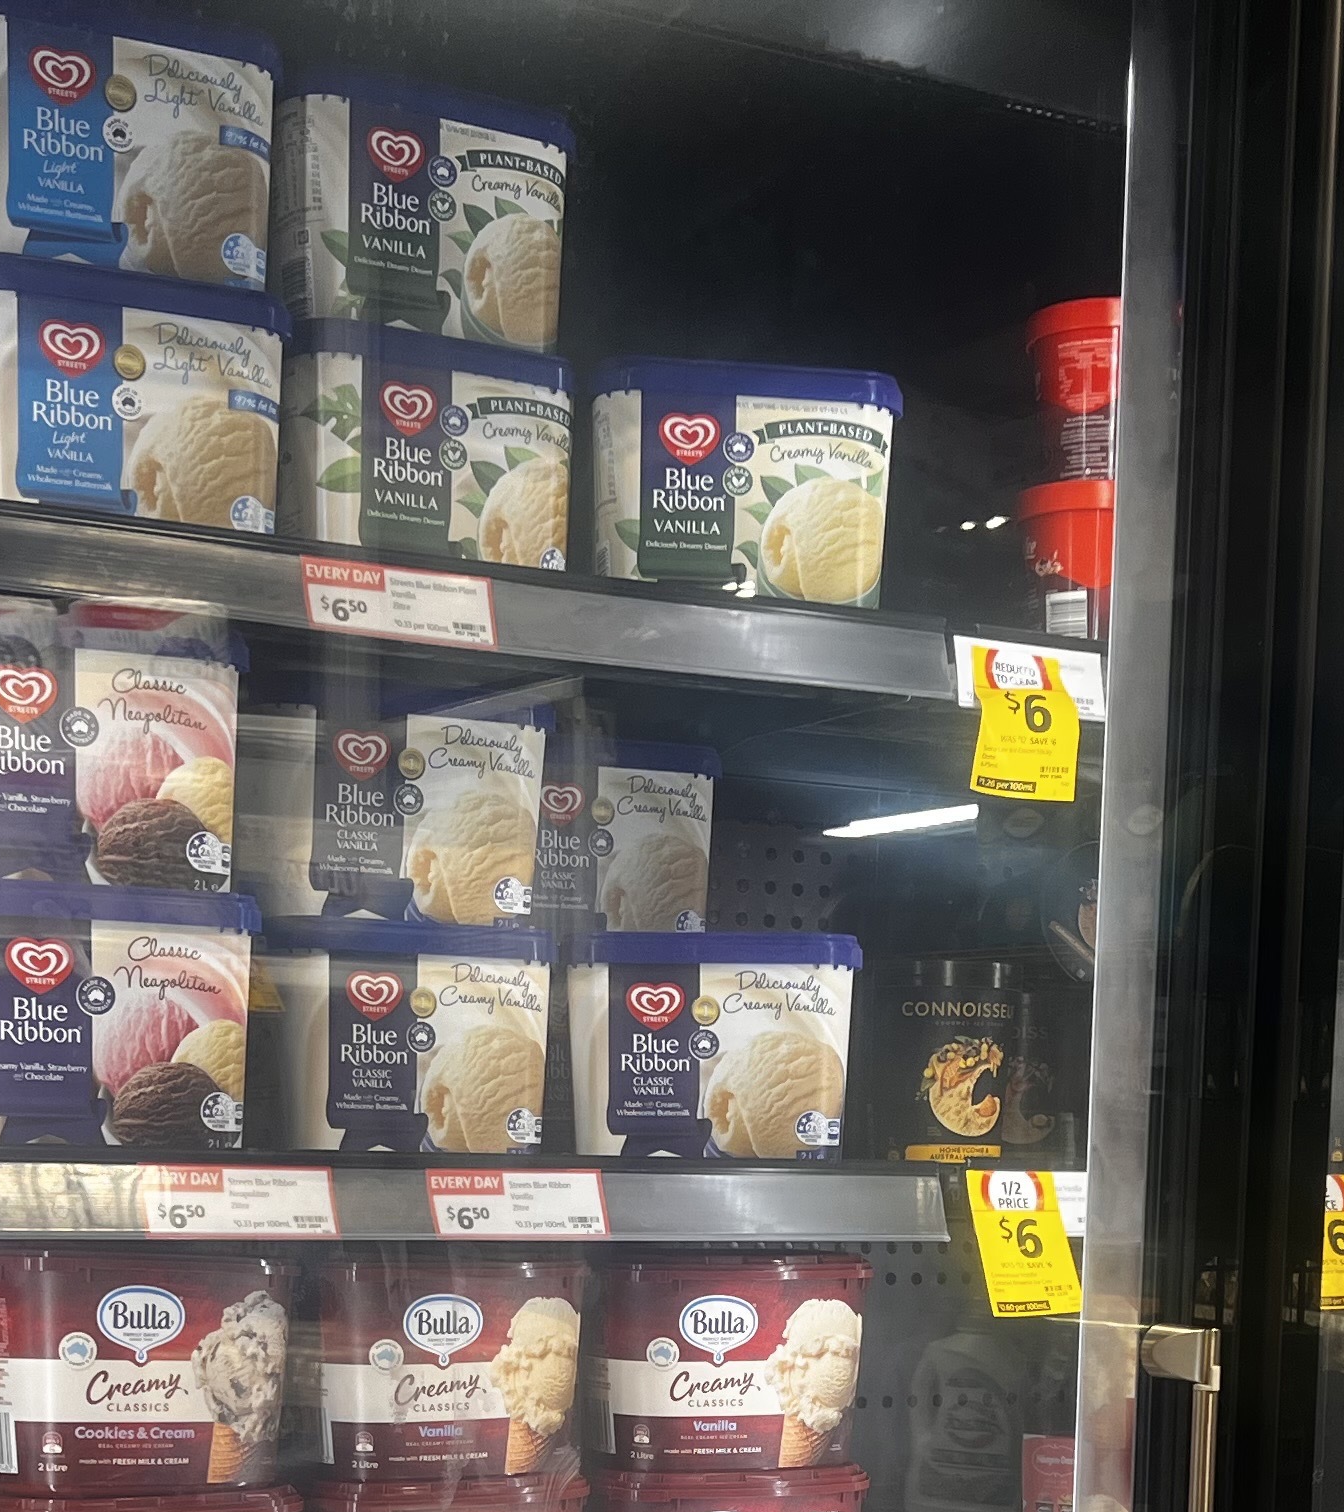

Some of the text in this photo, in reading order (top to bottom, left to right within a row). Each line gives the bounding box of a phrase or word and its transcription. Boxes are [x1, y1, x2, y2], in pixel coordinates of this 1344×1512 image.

[45, 380, 100, 407] Blue
[32, 402, 113, 431] Ribbon
[778, 421, 874, 443] PLANT-BASED
[47, 448, 94, 465] VANILLA
[770, 445, 873, 469] Creamy Vanilla
[664, 467, 714, 493] Blue
[652, 489, 726, 513] Ribbon
[653, 519, 721, 536] VANILLA
[305, 565, 382, 585] EVERY DAY
[128, 937, 202, 962] Classic
[116, 966, 222, 1000] Neapolitan
[735, 971, 821, 1001] Deliciously
[723, 992, 836, 1018] Creamy Vanilla
[633, 1077, 673, 1088] CLASSIC
[633, 1086, 674, 1096] VANILLA
[1001, 1182, 1022, 1195] 1/2
[999, 1198, 1028, 1210] PRICE
[110, 1300, 172, 1331] Bulla
[691, 1310, 748, 1337] Bulla
[86, 1370, 186, 1405] Creamy
[106, 1401, 169, 1413] CLASSICS
[75, 1425, 195, 1440] Cookies & Cream
[693, 1419, 737, 1433] Vanilla
